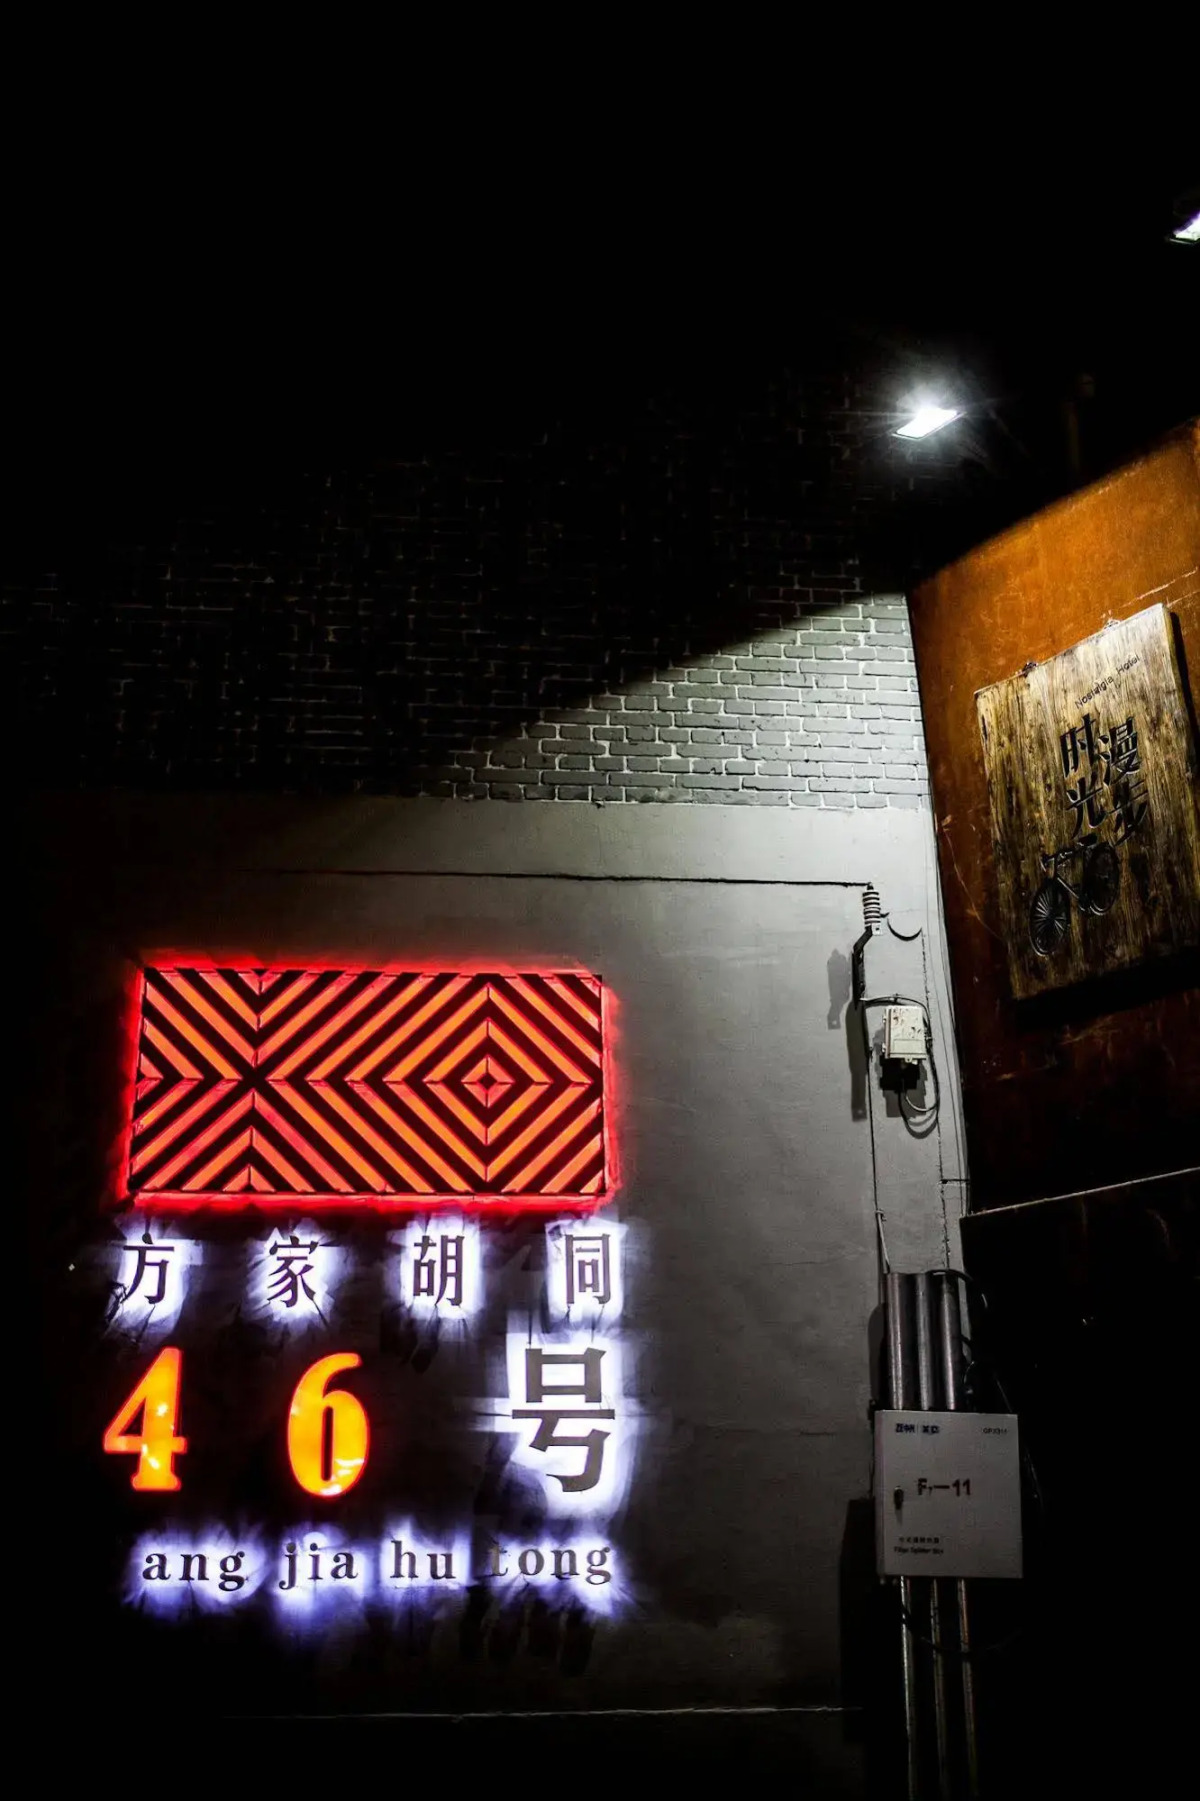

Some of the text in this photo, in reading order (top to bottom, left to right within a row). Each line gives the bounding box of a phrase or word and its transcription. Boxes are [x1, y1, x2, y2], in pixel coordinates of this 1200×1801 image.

[1074, 655, 1141, 710] Nostalgia Hotel
[122, 1233, 612, 1308] 方家胡同
[142, 1540, 612, 1592] ang jia hu tong
